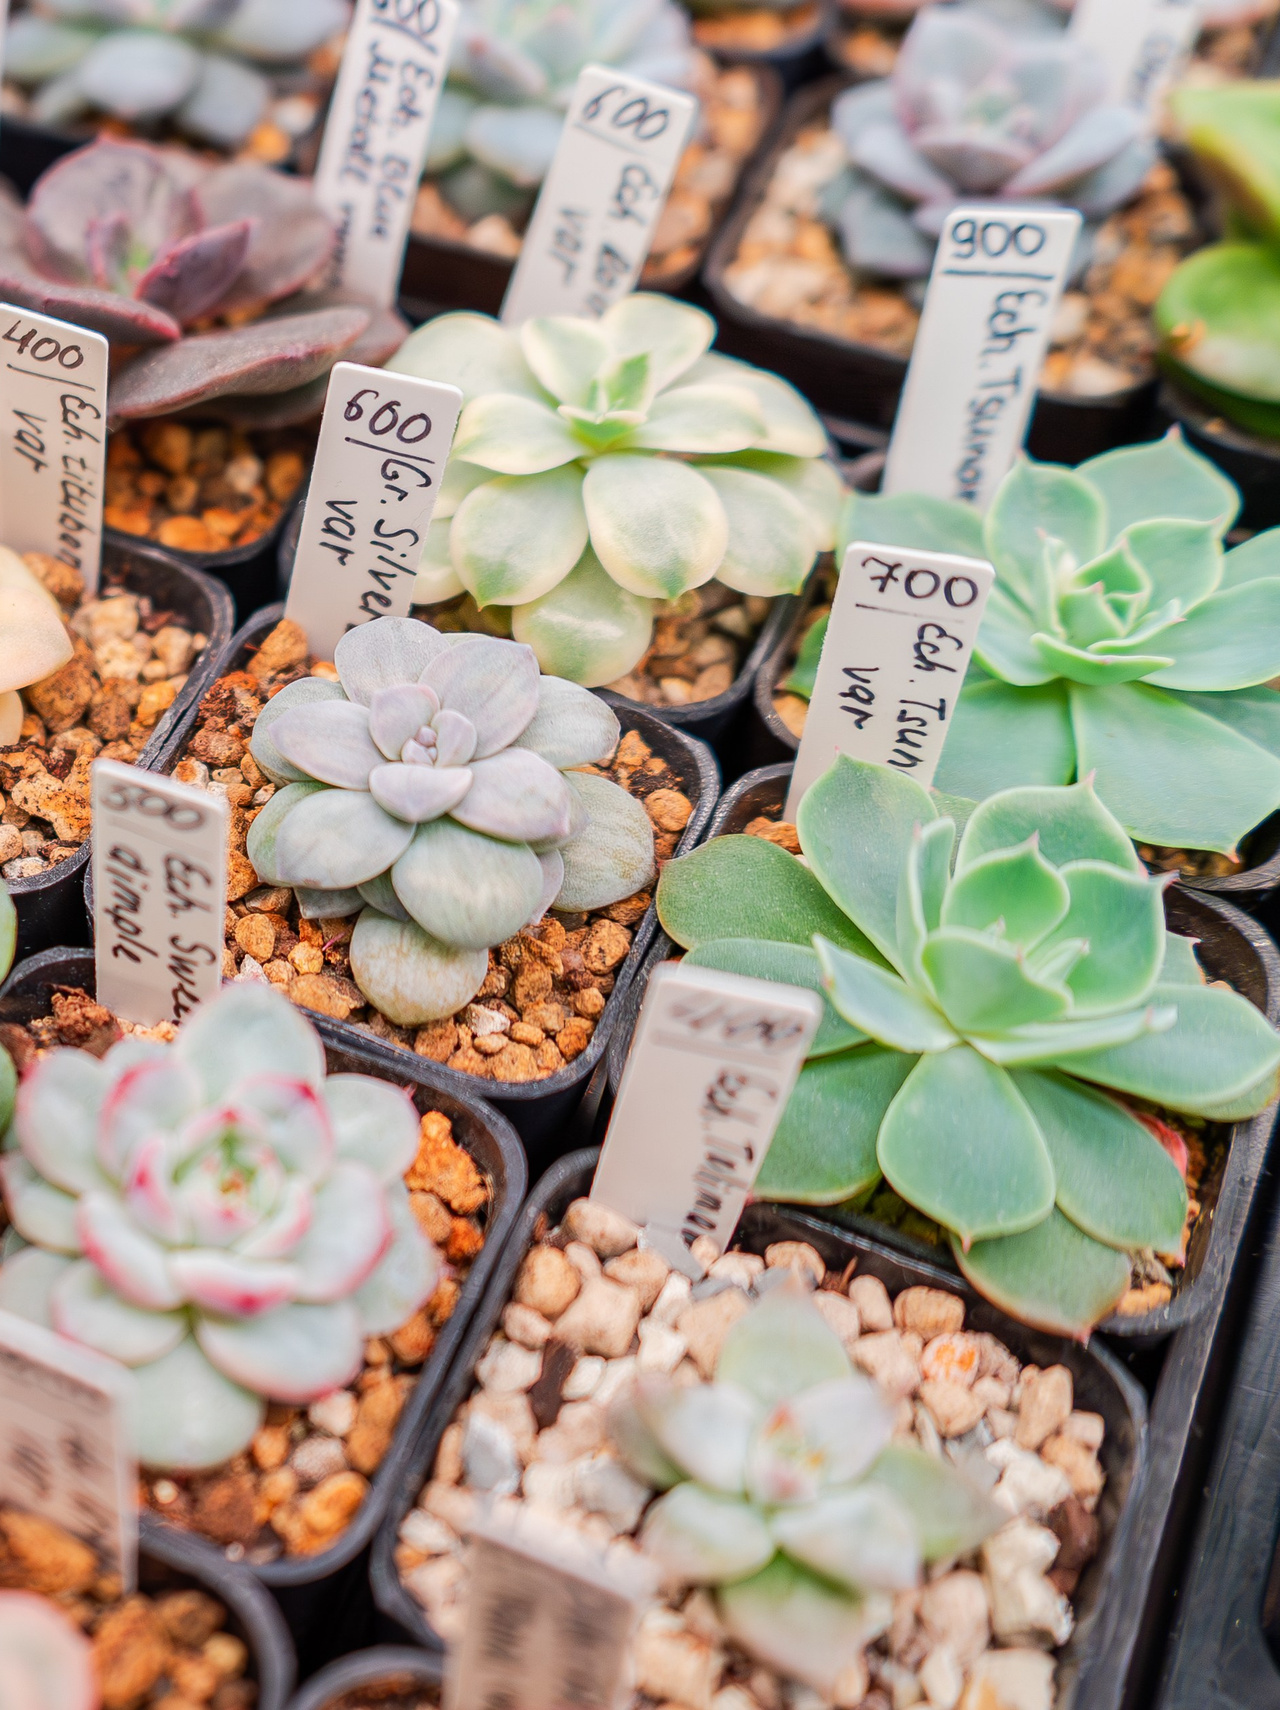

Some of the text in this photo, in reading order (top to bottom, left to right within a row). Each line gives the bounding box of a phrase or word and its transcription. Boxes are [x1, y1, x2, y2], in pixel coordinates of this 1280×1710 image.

[583, 84, 670, 140] 600
[952, 219, 1047, 258] 900
[1, 319, 84, 370] 400
[12, 409, 49, 474] var
[60, 393, 101, 445] Ech.
[343, 389, 432, 444] 600
[319, 501, 358, 566] var
[861, 556, 979, 607] 700
[908, 623, 963, 683] Ech.
[838, 667, 879, 730] var
[104, 846, 160, 964] dimple
